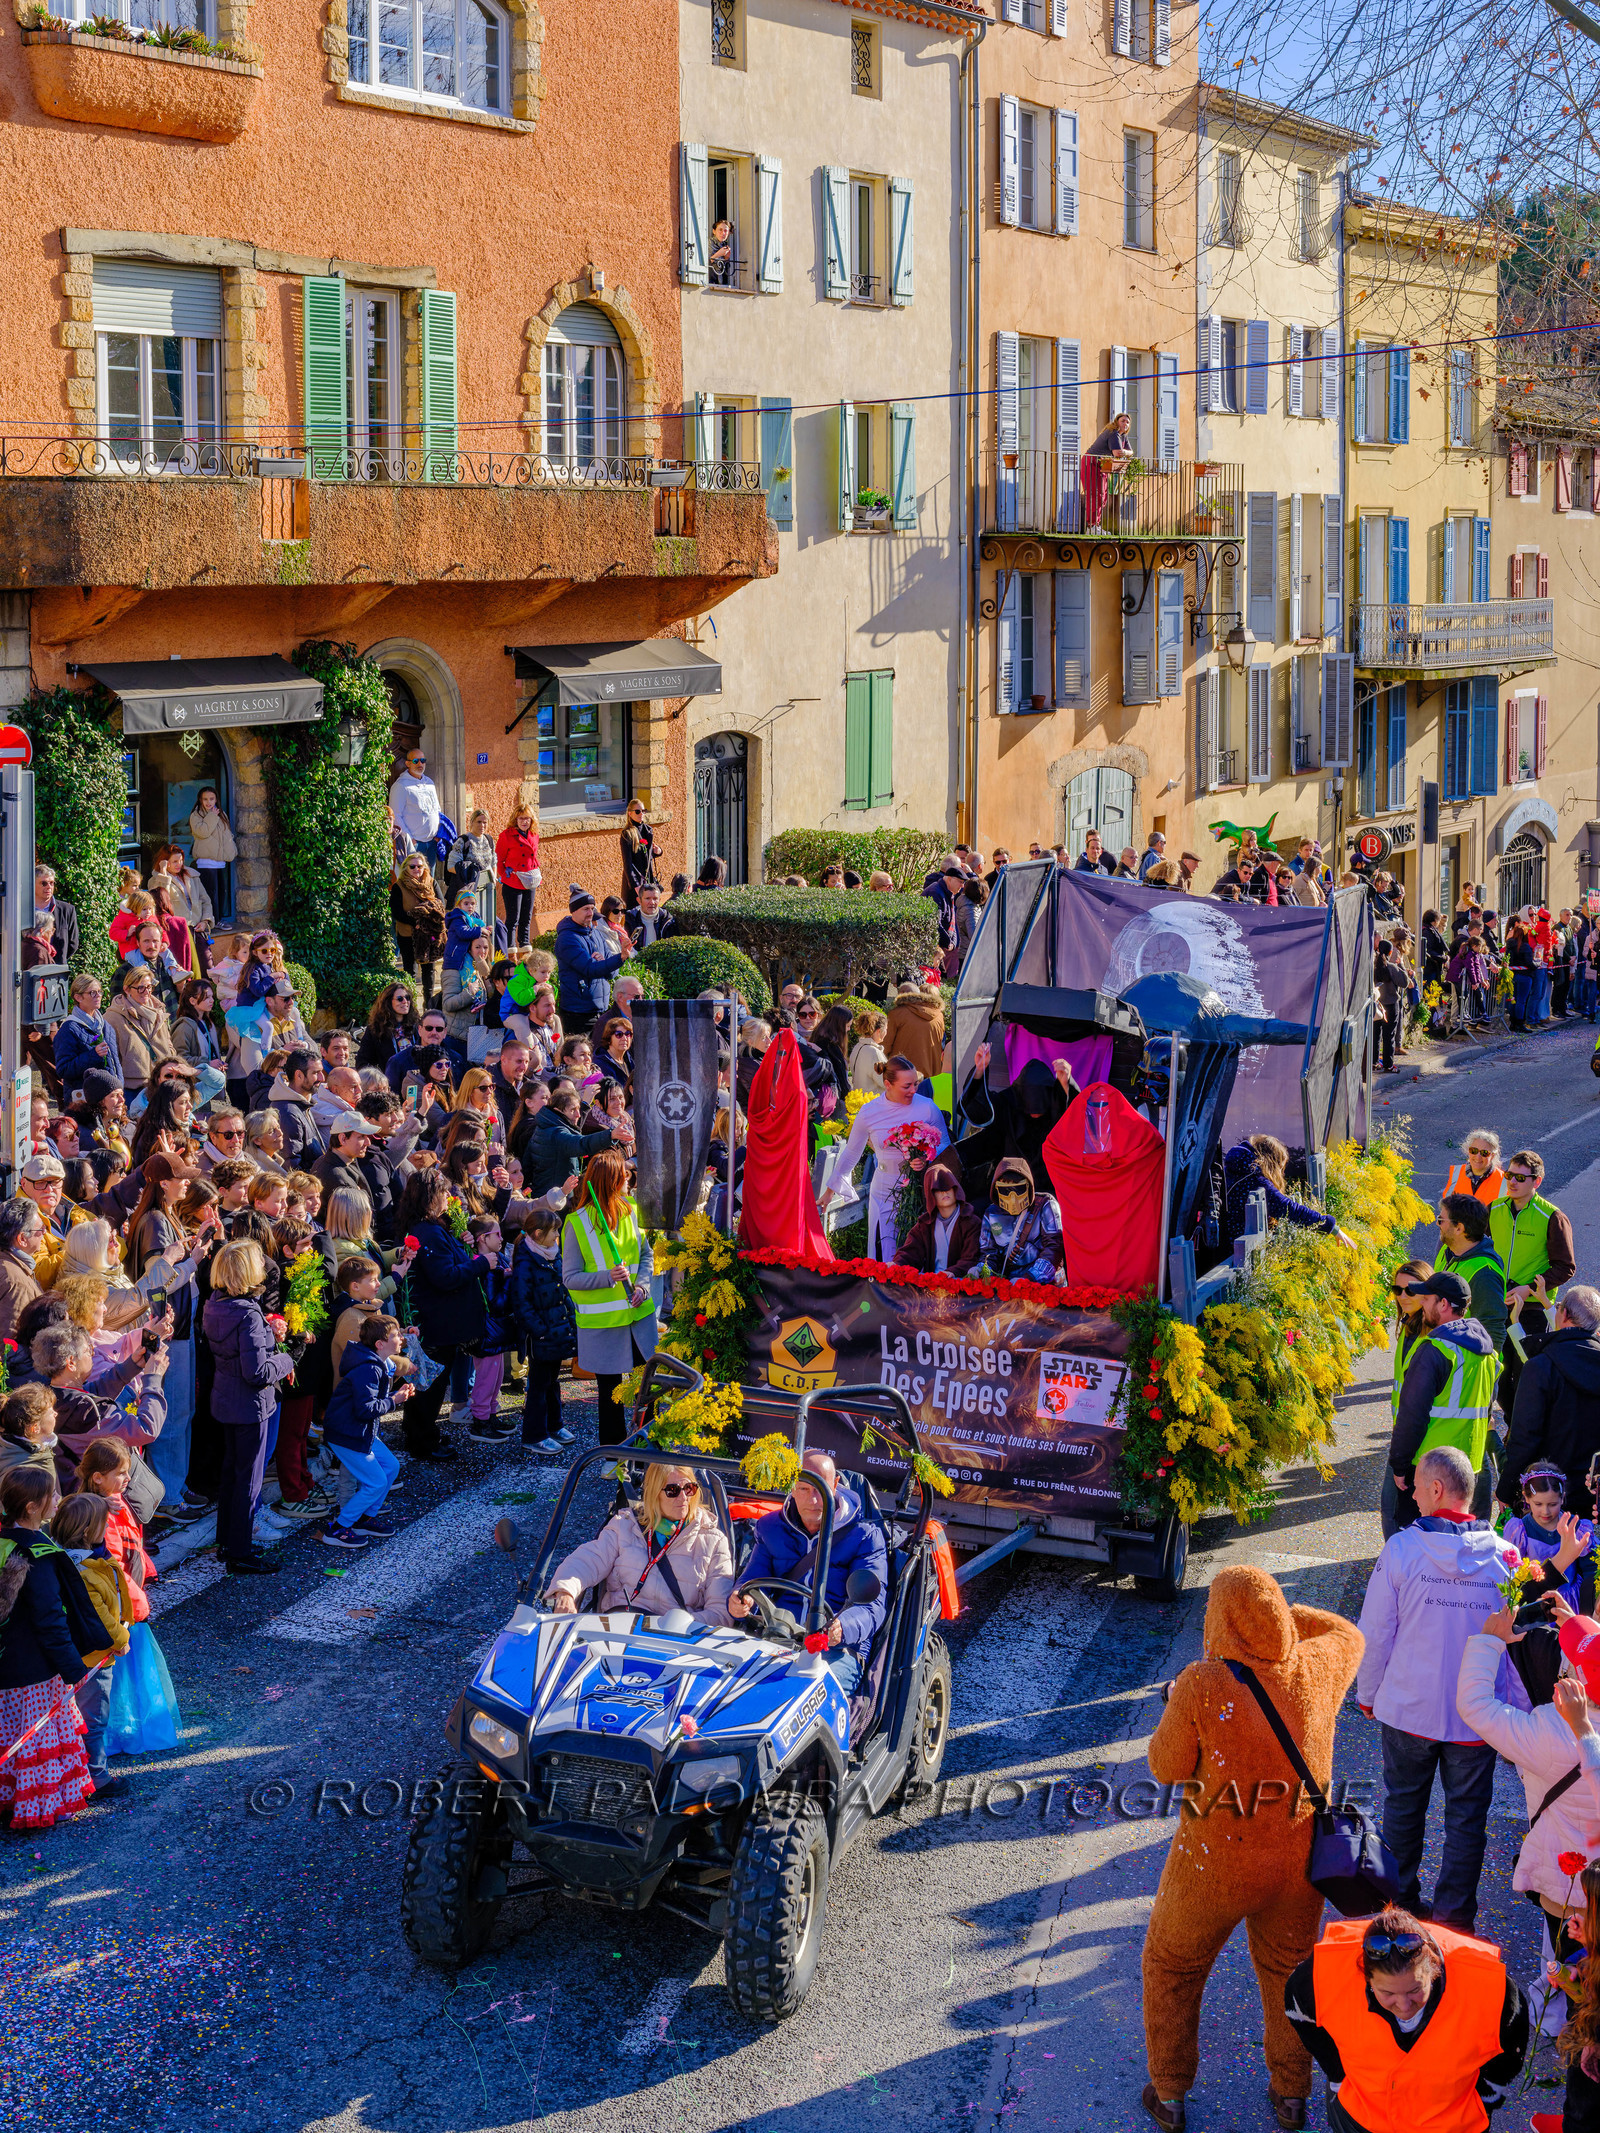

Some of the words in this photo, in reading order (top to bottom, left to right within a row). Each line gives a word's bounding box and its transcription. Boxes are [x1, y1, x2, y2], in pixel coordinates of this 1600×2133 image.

[620, 677, 652, 688] MAGREY
[654, 676, 660, 686] &
[661, 675, 681, 685] SONS
[194, 700, 239, 714] MAGREY
[242, 700, 250, 711] &
[252, 697, 280, 710] SONS
[1360, 828, 1383, 839] BARNES
[1366, 837, 1378, 854] B
[800, 1334, 807, 1346] 8
[880, 1325, 909, 1363] La
[916, 1329, 1013, 1377] Croisée
[1044, 1358, 1102, 1377] STAR
[1044, 1370, 1102, 1390] WARS
[878, 1362, 925, 1406] Des
[932, 1361, 1009, 1419] Épées
[929, 1424, 952, 1437] pour
[952, 1426, 972, 1440] tous
[973, 1430, 984, 1442] et
[984, 1432, 1006, 1445] sous
[1008, 1434, 1037, 1449] toutes
[1038, 1440, 1054, 1452] ses
[1056, 1440, 1088, 1456] formes
[1090, 1444, 1096, 1456] !
[1013, 1478, 1018, 1486] 3
[1020, 1478, 1036, 1488] RUE
[1037, 1480, 1048, 1489] DU
[1050, 1482, 1077, 1494] FRÊNE,
[1078, 1486, 1122, 1499] VALBONNE
[1420, 1574, 1452, 1585] Réserve
[1453, 1576, 1498, 1589] Communale
[1424, 1596, 1434, 1605] de
[1436, 1598, 1468, 1609] Sécurité
[1469, 1601, 1492, 1611] Civile
[628, 1676, 646, 1684] 15
[594, 1684, 664, 1700] POLARIS
[580, 1692, 664, 1712] RZR
[779, 1682, 828, 1748] POLARIS
